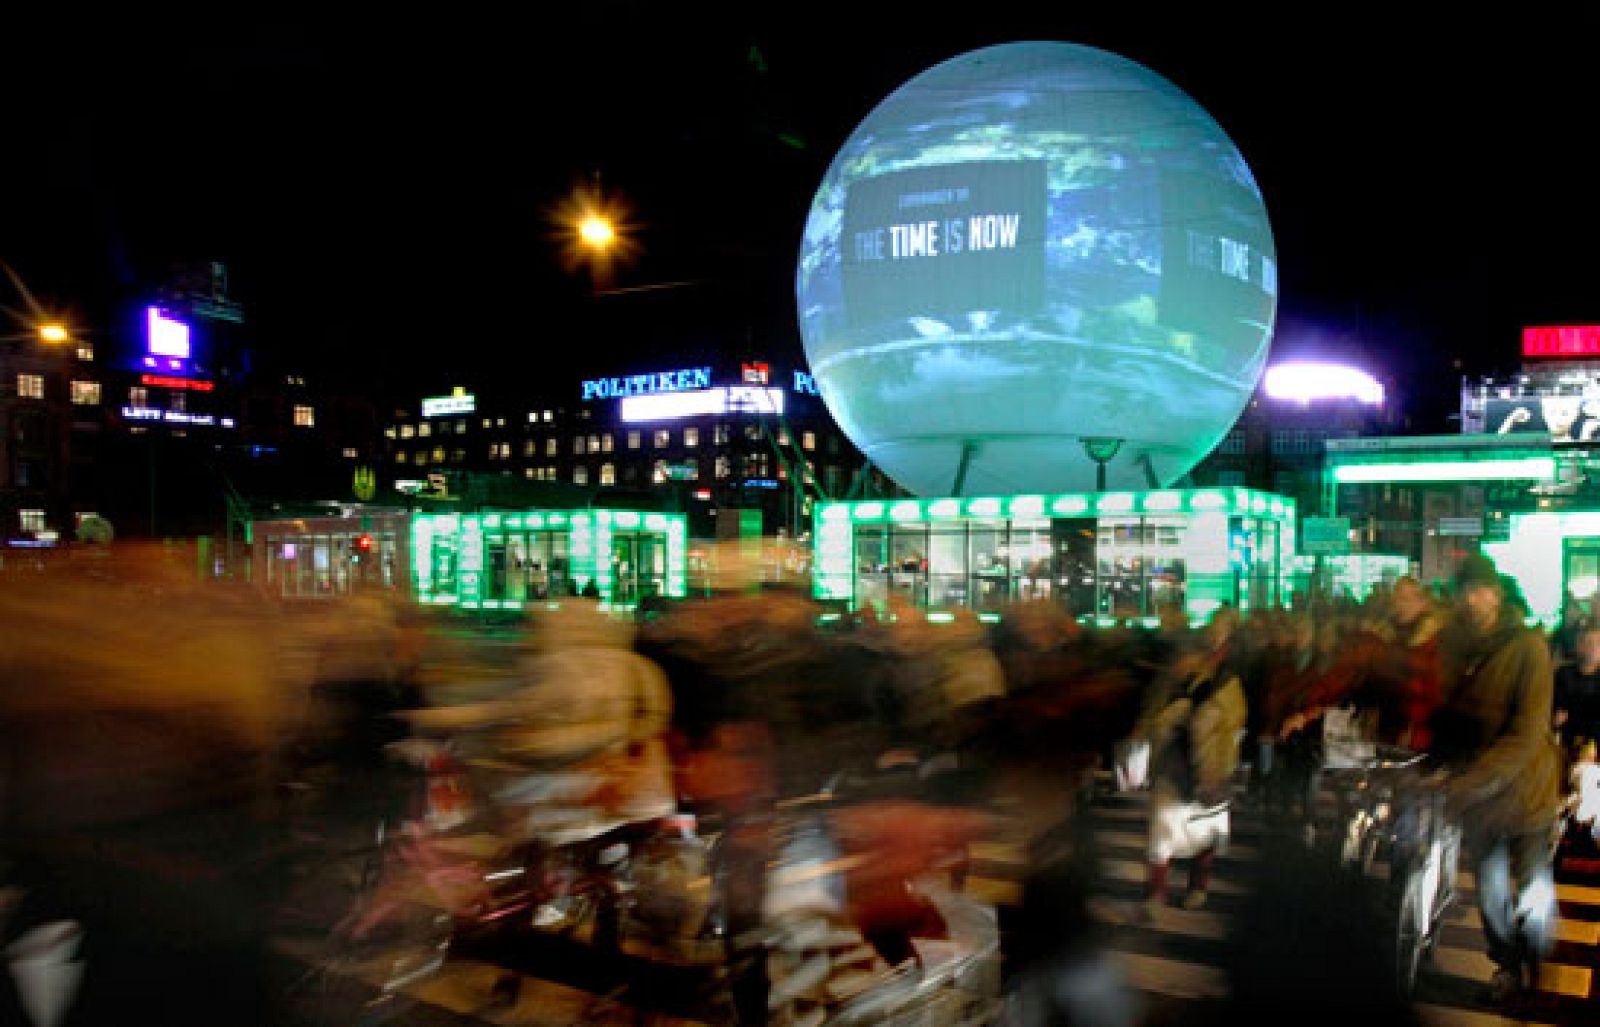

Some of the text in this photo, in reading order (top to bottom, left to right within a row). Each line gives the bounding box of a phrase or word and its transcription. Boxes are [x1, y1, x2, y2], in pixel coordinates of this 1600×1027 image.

[853, 212, 1020, 260] THE TIME IS NOW
[581, 365, 712, 400] POLITIKEN
